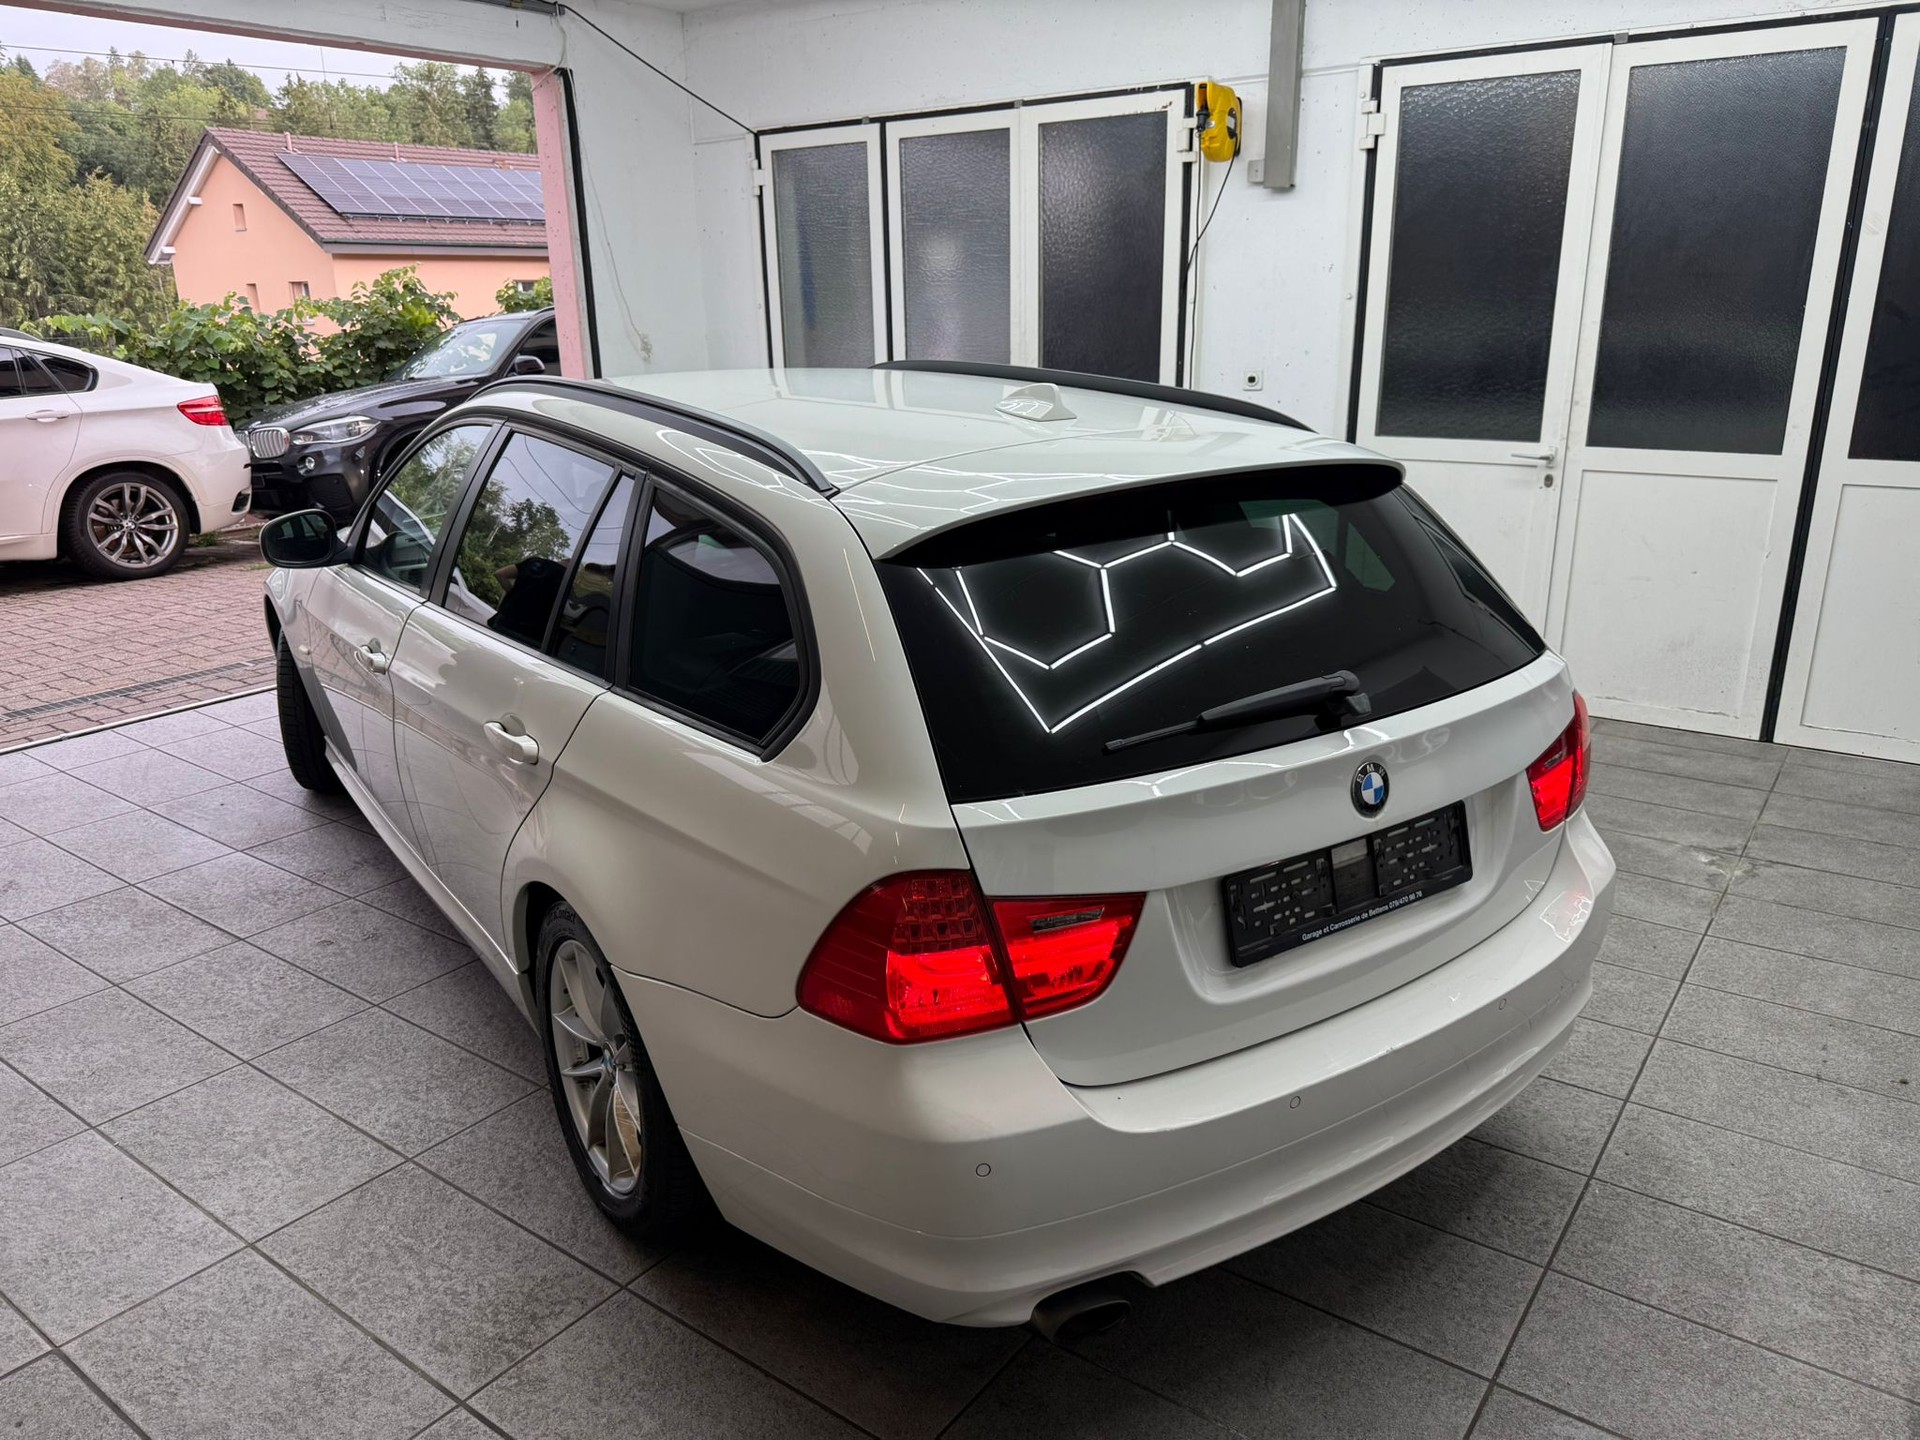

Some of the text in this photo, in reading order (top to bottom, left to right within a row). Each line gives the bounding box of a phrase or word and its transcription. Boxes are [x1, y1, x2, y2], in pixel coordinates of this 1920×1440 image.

[1356, 763, 1386, 783] BMW
[1301, 929, 1323, 941] Garage
[1330, 914, 1361, 931] Carrosserie
